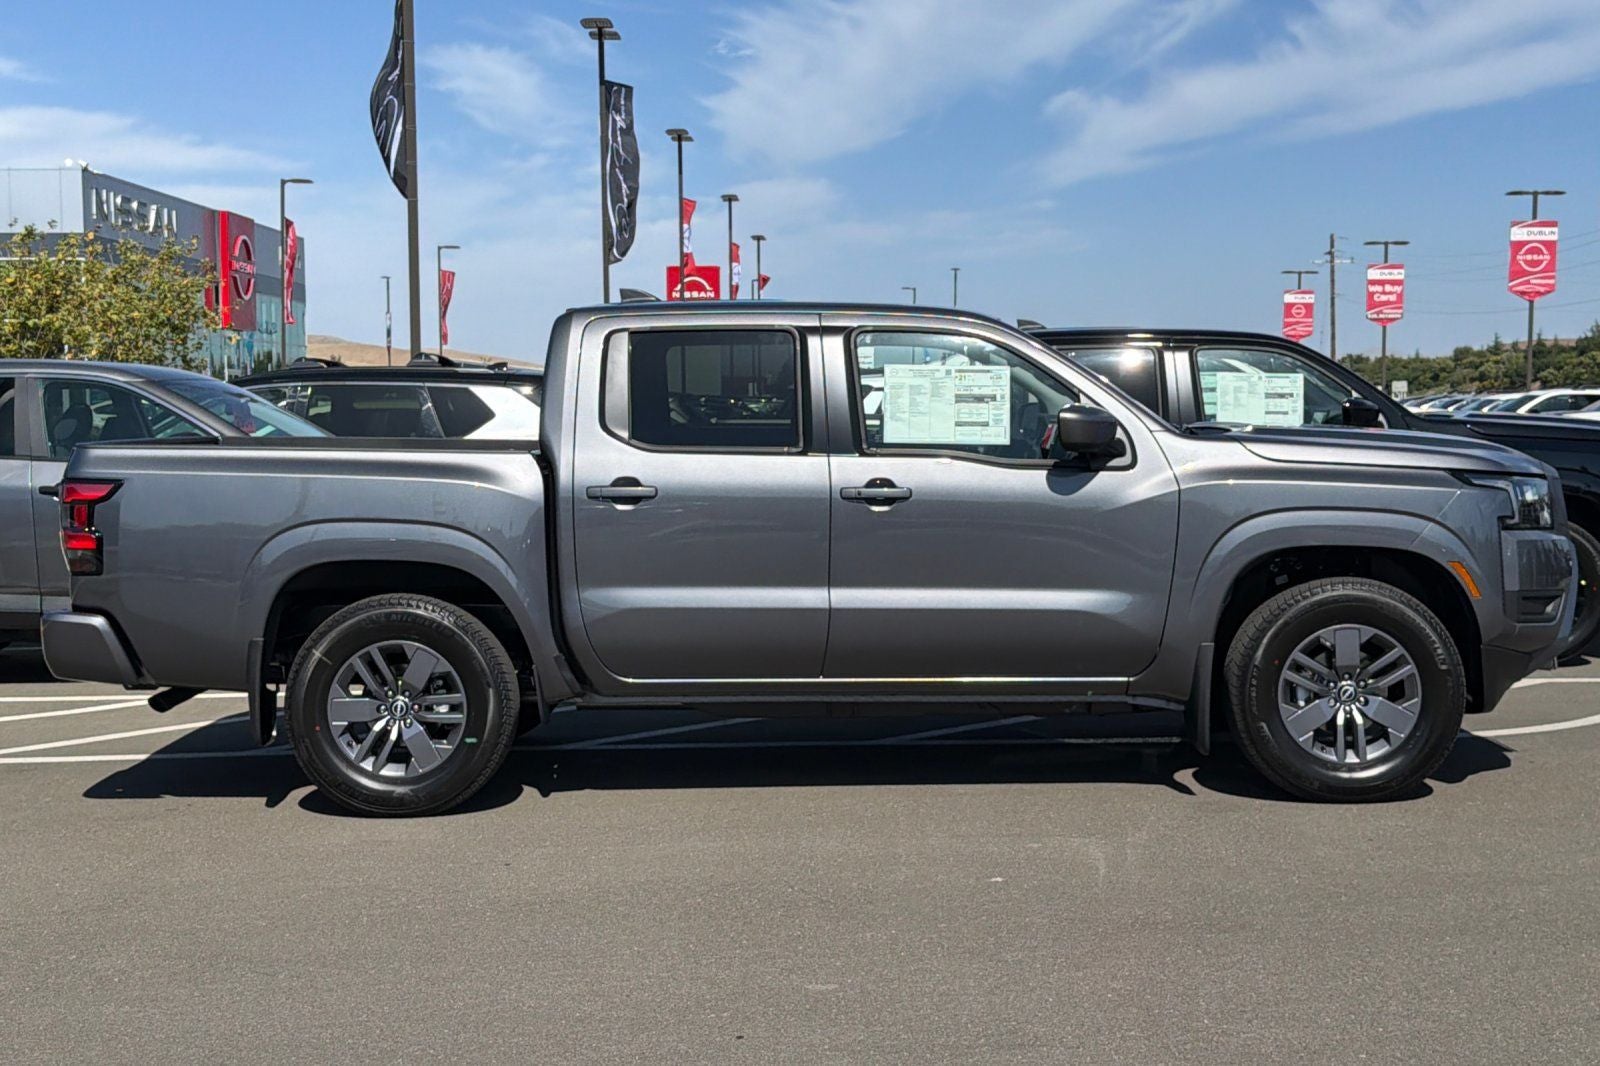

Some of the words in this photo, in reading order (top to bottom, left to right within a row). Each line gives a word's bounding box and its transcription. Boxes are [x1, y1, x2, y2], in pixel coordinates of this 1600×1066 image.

[91, 187, 177, 237] NISSAN
[1368, 284, 1383, 292] We
[1384, 284, 1403, 294] Buy
